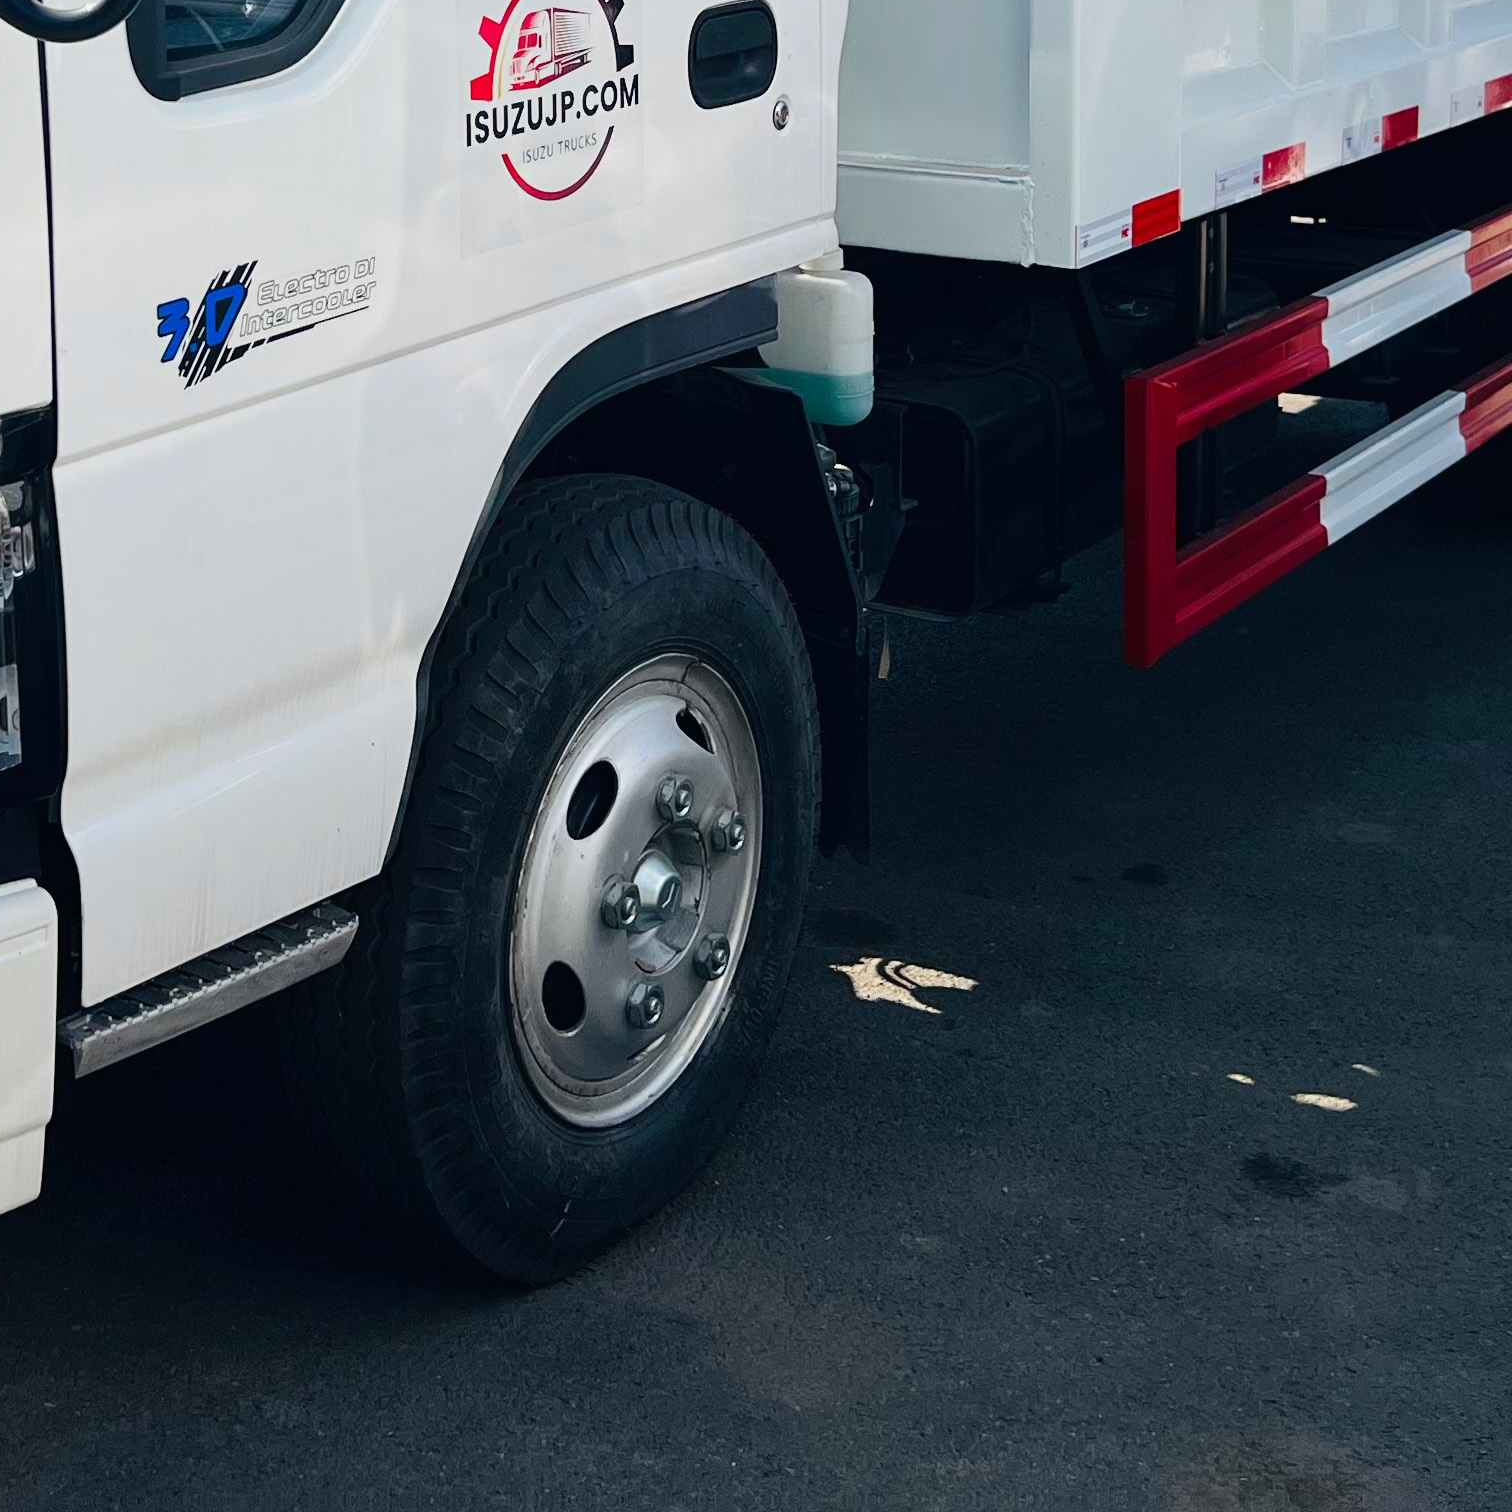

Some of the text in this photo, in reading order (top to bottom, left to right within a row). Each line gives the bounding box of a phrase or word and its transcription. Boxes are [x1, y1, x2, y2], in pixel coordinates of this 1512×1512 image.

[466, 73, 639, 147] ISUZUJP.COM
[522, 132, 598, 164] ISUZU TRUCKS
[239, 281, 377, 337] Intercooler
